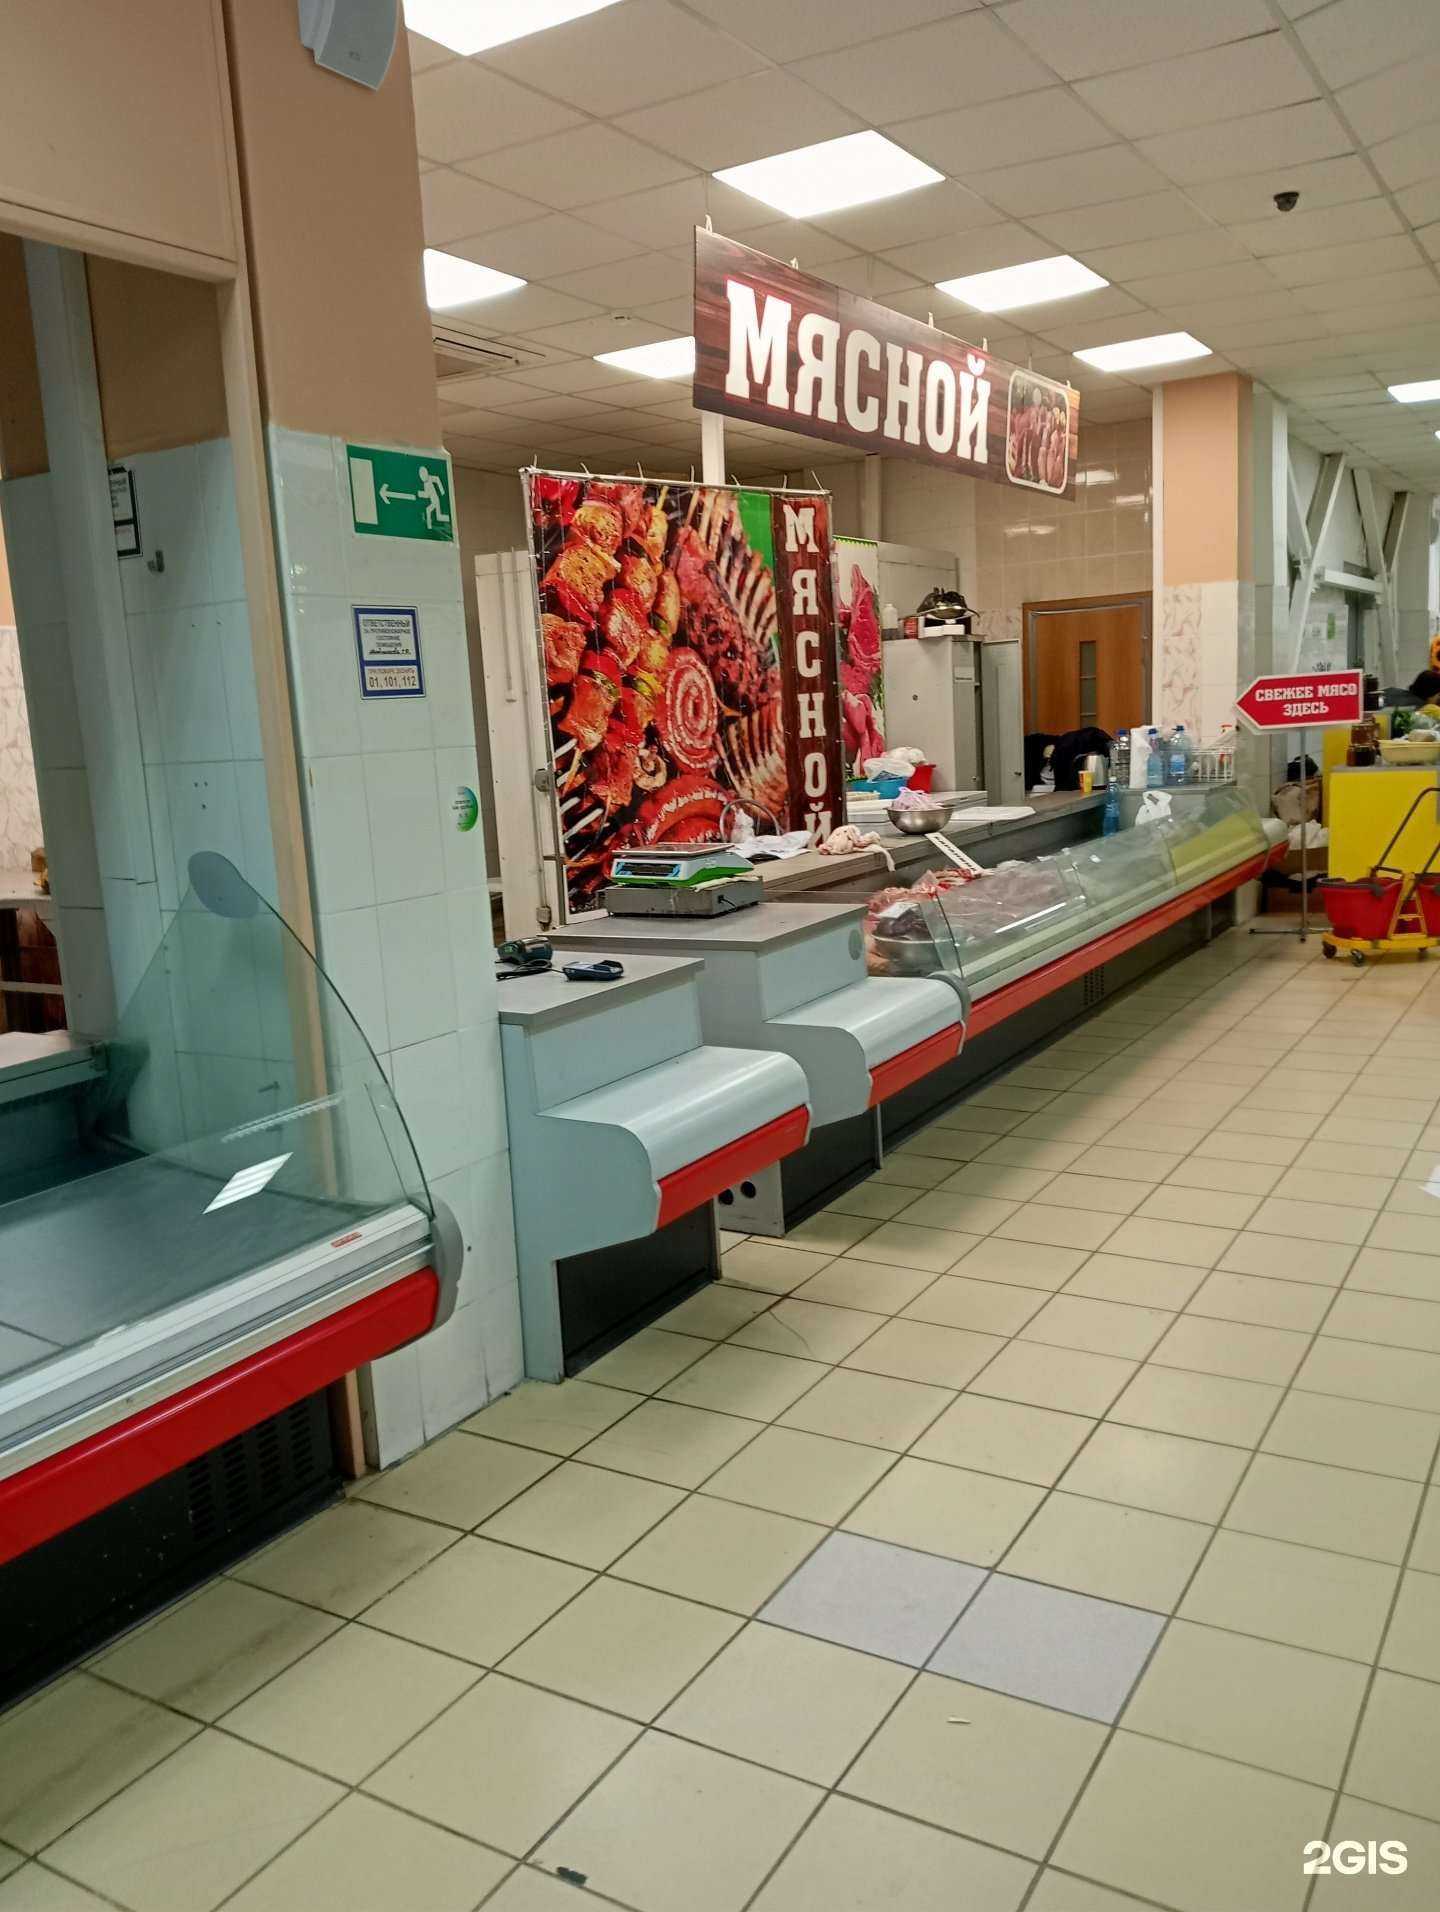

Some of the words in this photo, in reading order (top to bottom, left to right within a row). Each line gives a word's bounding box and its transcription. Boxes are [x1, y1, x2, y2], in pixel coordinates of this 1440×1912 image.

[724, 279, 991, 465] МЯСНОЙ
[782, 504, 832, 850] МЯСНОЙ
[1255, 686, 1314, 702] СВЕЖЕЕ
[1317, 683, 1358, 698] МЯСО
[1282, 701, 1330, 717] ЗДЕСЬ
